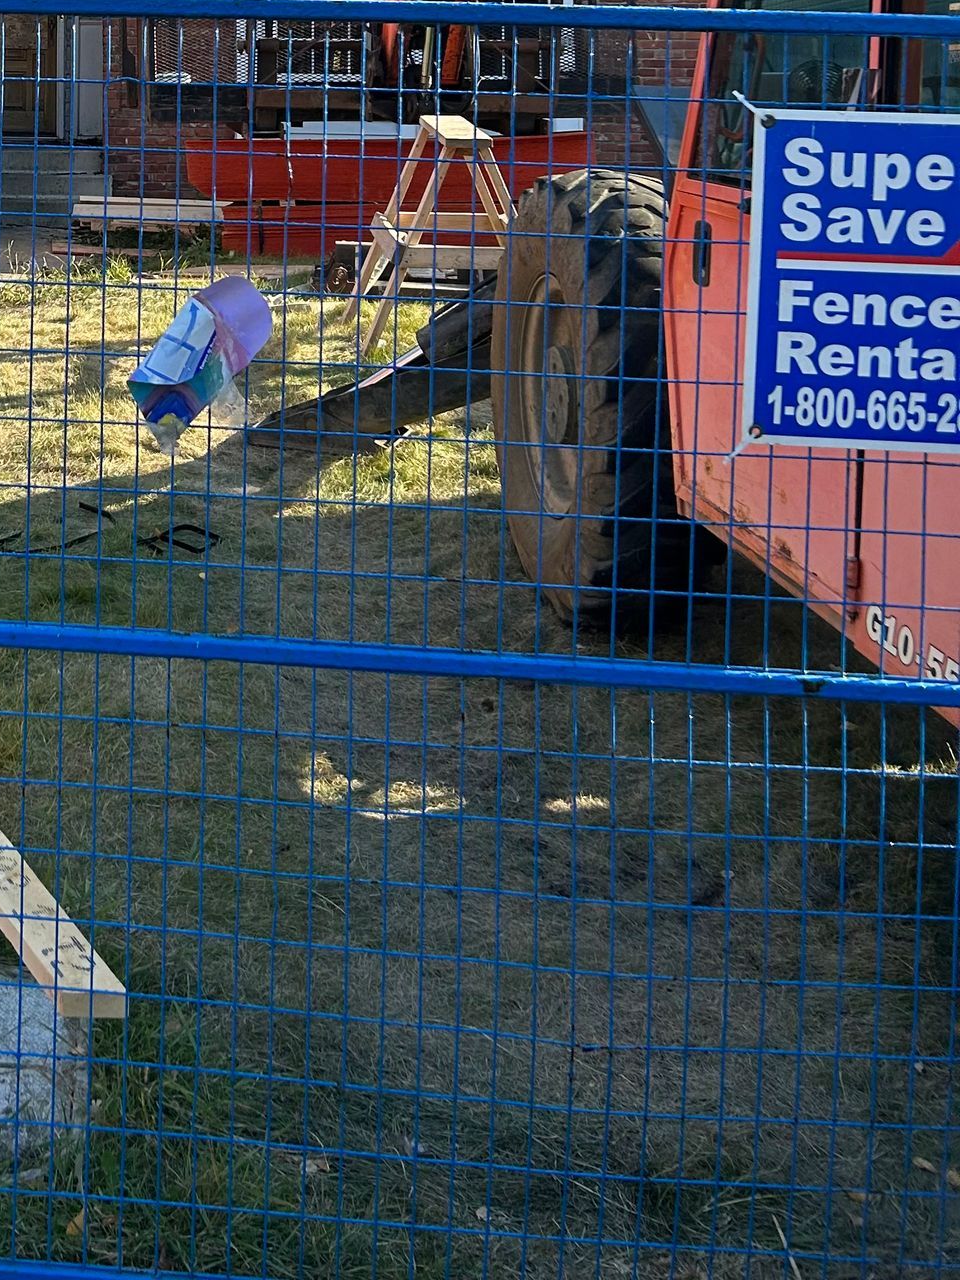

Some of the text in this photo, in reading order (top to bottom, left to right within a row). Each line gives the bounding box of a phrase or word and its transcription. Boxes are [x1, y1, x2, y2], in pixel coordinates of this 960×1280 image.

[782, 137, 955, 201] Supe
[779, 193, 946, 247] Save
[777, 280, 960, 329] Fence
[776, 331, 956, 382] Renta
[767, 385, 960, 434] 1-800-665-2
